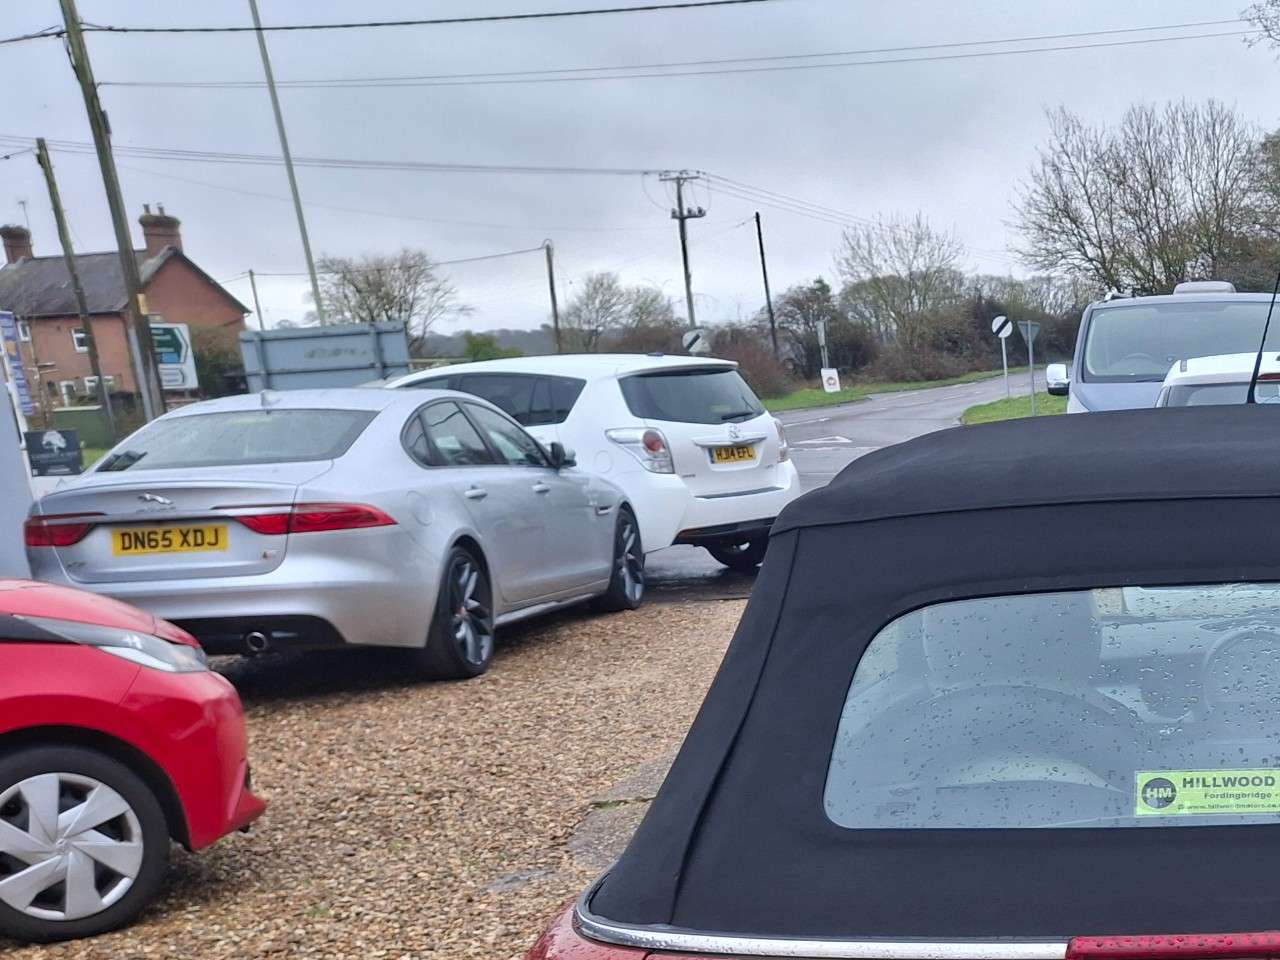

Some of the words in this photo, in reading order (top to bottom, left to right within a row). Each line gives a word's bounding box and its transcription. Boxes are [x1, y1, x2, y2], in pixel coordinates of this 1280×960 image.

[121, 531, 172, 551] DN65
[178, 528, 219, 547] XDJ
[1182, 775, 1276, 788] HILLWOOD
[1146, 787, 1172, 799] HM
